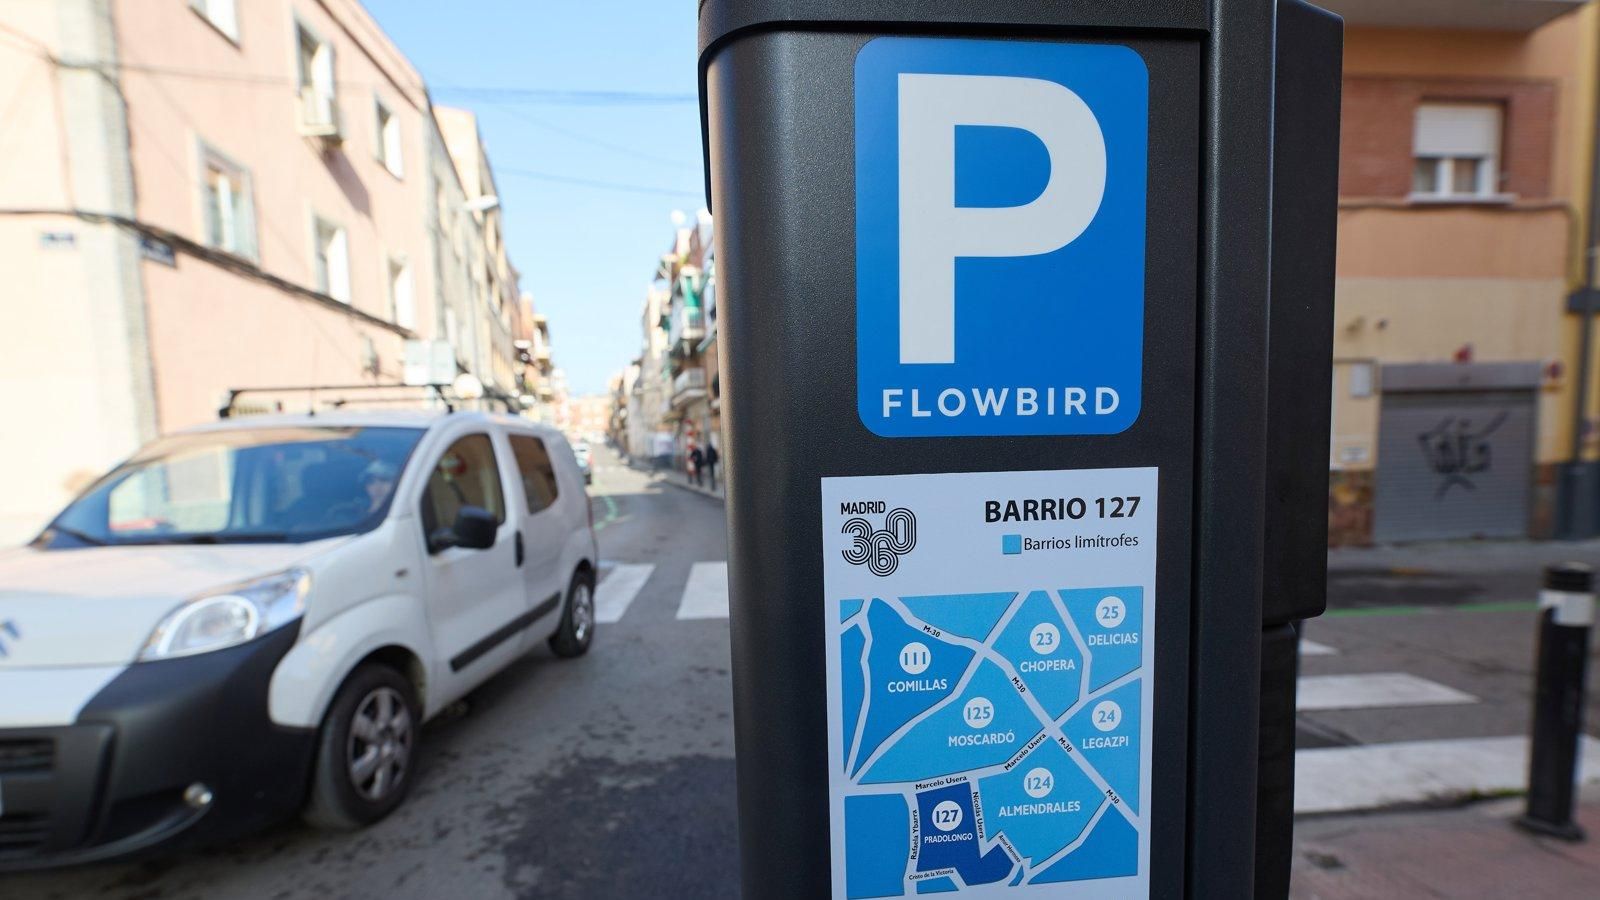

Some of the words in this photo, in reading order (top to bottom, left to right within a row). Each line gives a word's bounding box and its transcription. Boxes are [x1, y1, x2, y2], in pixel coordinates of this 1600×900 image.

[898, 73, 1107, 364] P
[882, 387, 1120, 418] FLOWBIRD
[841, 501, 886, 515] MADRID
[985, 498, 1087, 523] BARRIO
[1095, 496, 1141, 519] 127
[841, 507, 917, 577] 360
[1024, 536, 1071, 551] Barrios
[1075, 533, 1139, 549] limítrofes
[1101, 606, 1119, 620] 25
[922, 625, 941, 638] M-30
[1036, 632, 1053, 646] 23
[1088, 632, 1138, 646] DELICIAS
[1020, 659, 1075, 673] CHOPERA
[887, 679, 948, 693] COMILLAS
[1011, 676, 1026, 693] M-30
[966, 705, 991, 720] 125
[1097, 709, 1115, 723] 24
[948, 729, 1015, 747] MOSCARDÓ
[1058, 737, 1073, 753] M-30
[1082, 735, 1129, 749] LEGAZPI
[1004, 749, 1029, 771] Marcelo
[1027, 733, 1047, 749] Usera
[915, 779, 944, 790] Marcelo
[945, 776, 968, 784] Usera
[1027, 776, 1051, 790] 124
[1105, 789, 1120, 804] M-30
[972, 791, 981, 818] Nicolás
[998, 800, 1081, 817] ALMENDRALES
[935, 809, 959, 823] 127
[976, 818, 984, 839] Usera
[924, 832, 973, 844] PRADOLONGO
[910, 834, 918, 860] Rafaela
